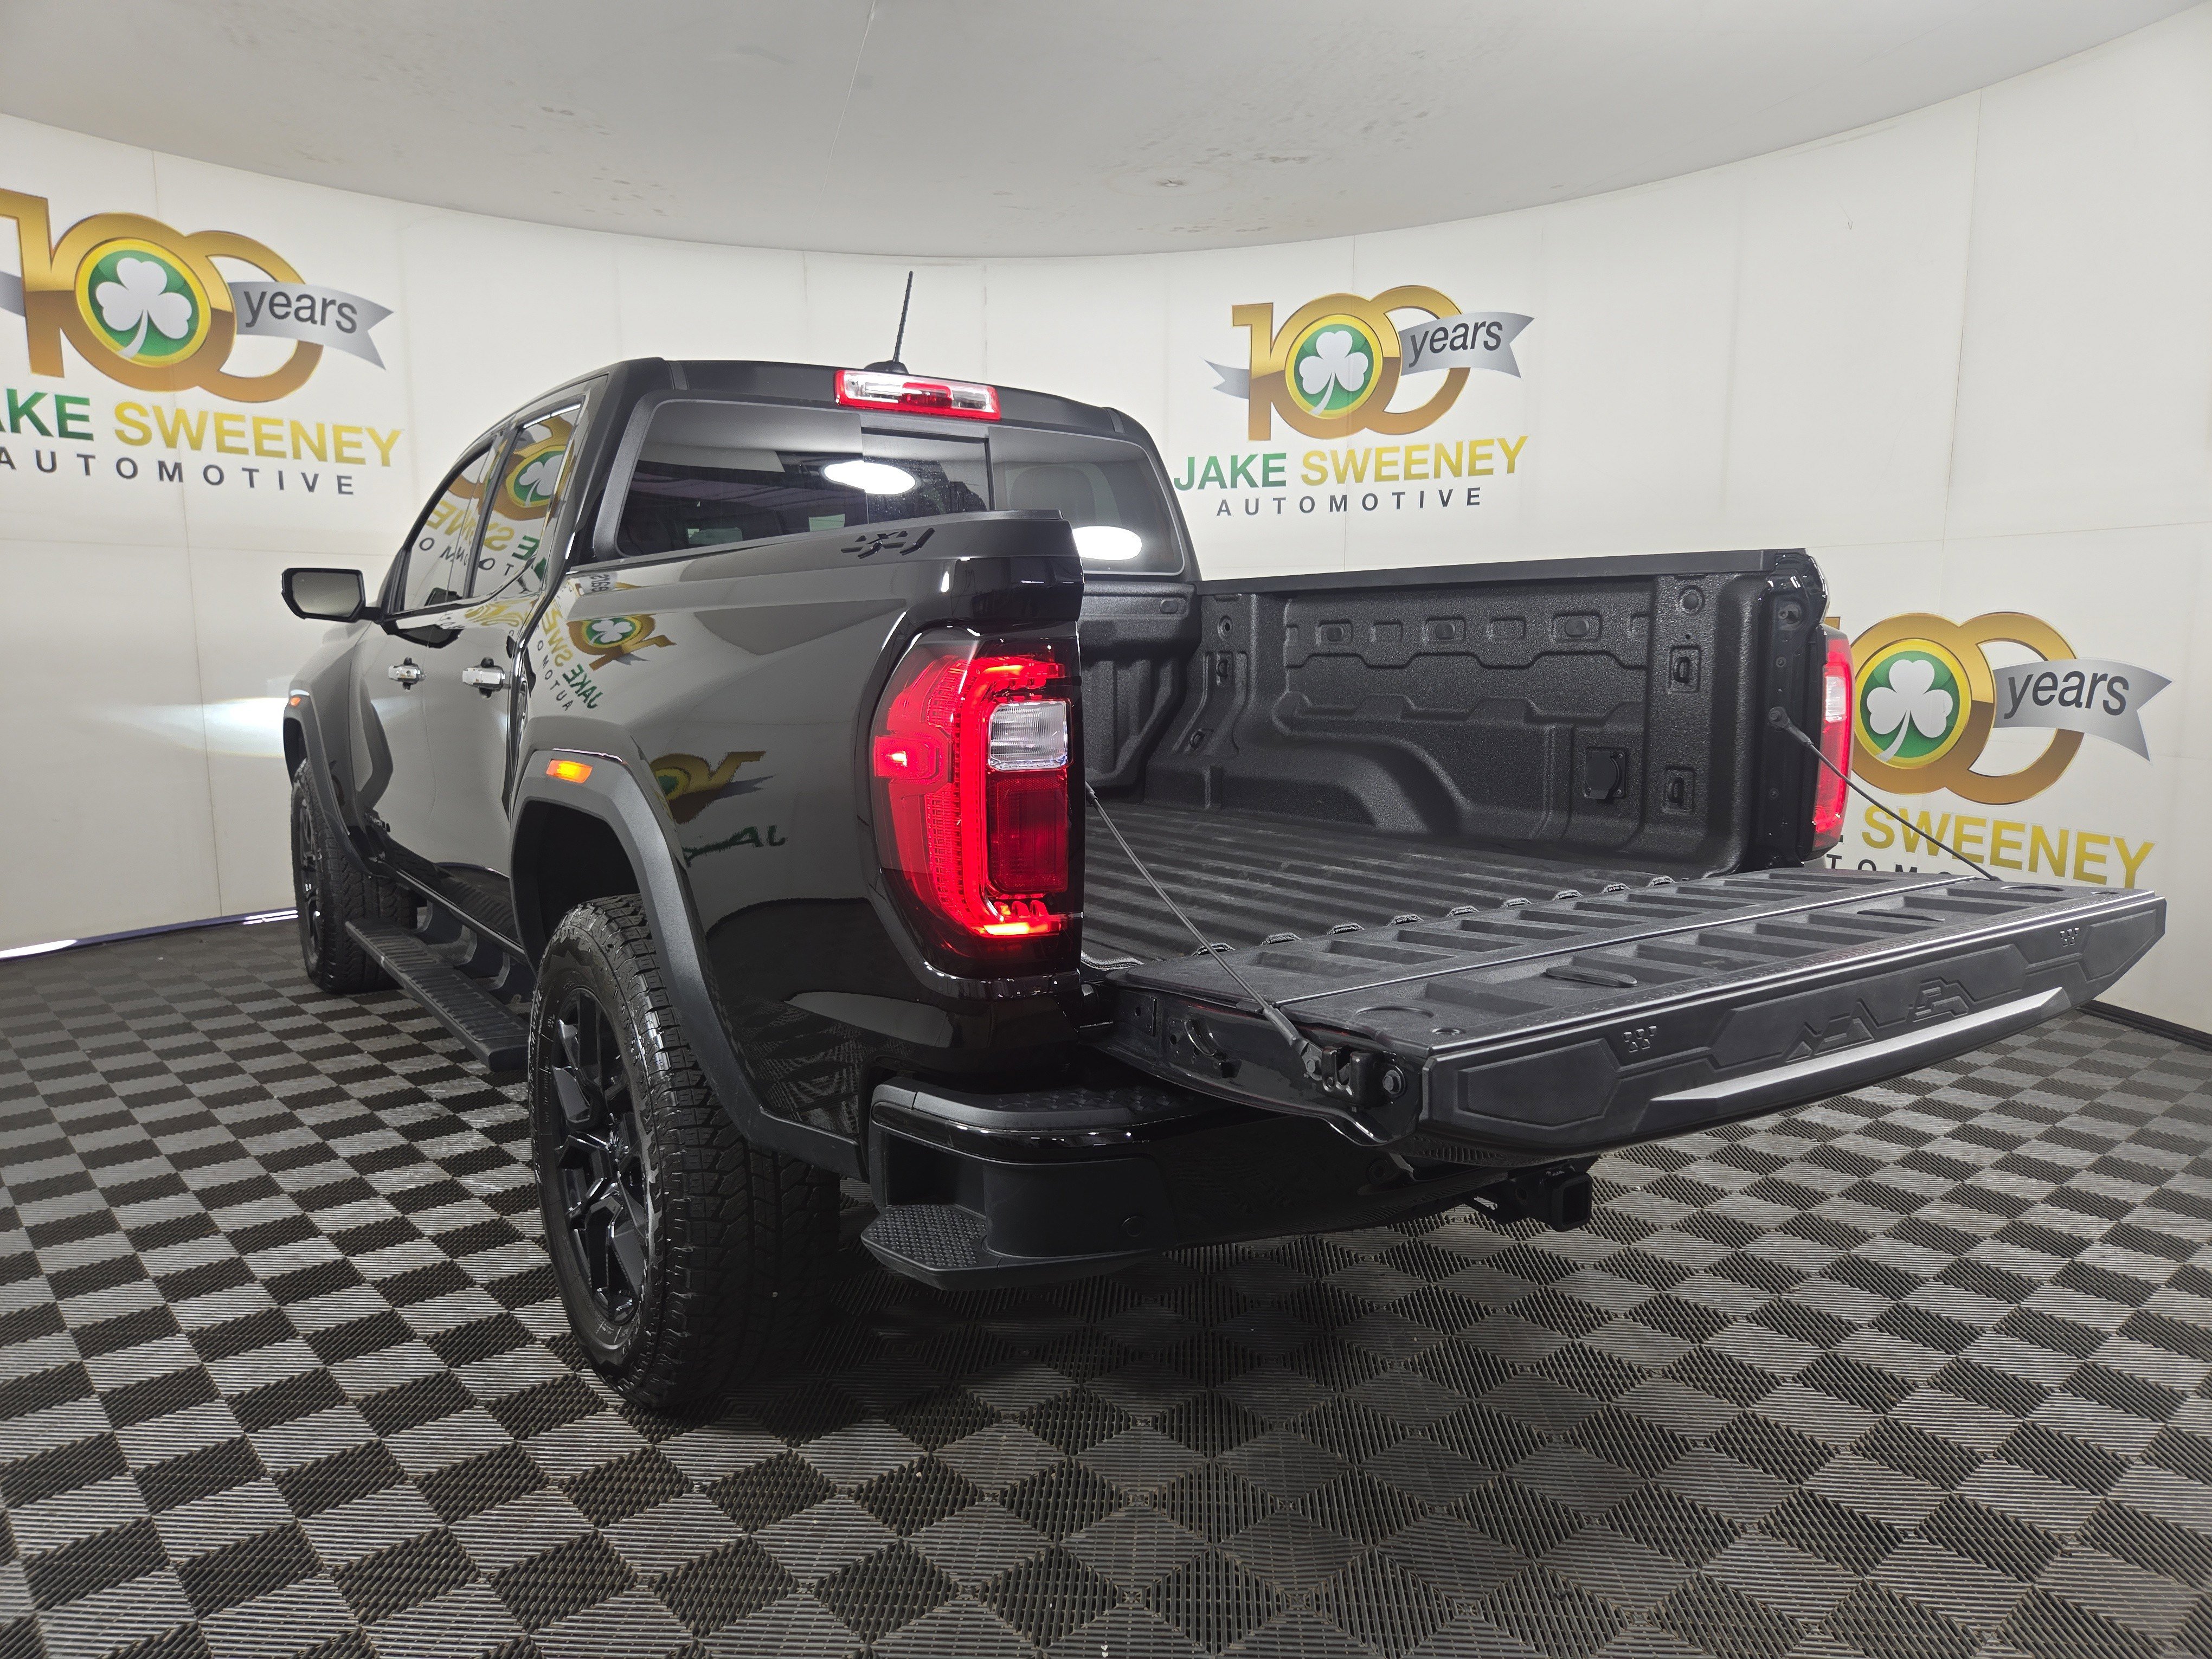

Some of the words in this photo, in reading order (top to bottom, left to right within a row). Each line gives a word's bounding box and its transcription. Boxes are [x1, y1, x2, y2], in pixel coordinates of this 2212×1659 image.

[243, 289, 358, 335] years
[1232, 285, 1471, 441] 100
[1408, 320, 1503, 368] years
[114, 400, 404, 467] SWEENEY
[0, 446, 354, 496] AUTOMOTIVE
[1173, 452, 1287, 491] JAKE
[1301, 435, 1529, 486] SWEENEY
[1216, 487, 1481, 517] AUTOMOTIVE
[2003, 670, 2130, 719] years
[1861, 804, 2155, 889] SWEENEY
